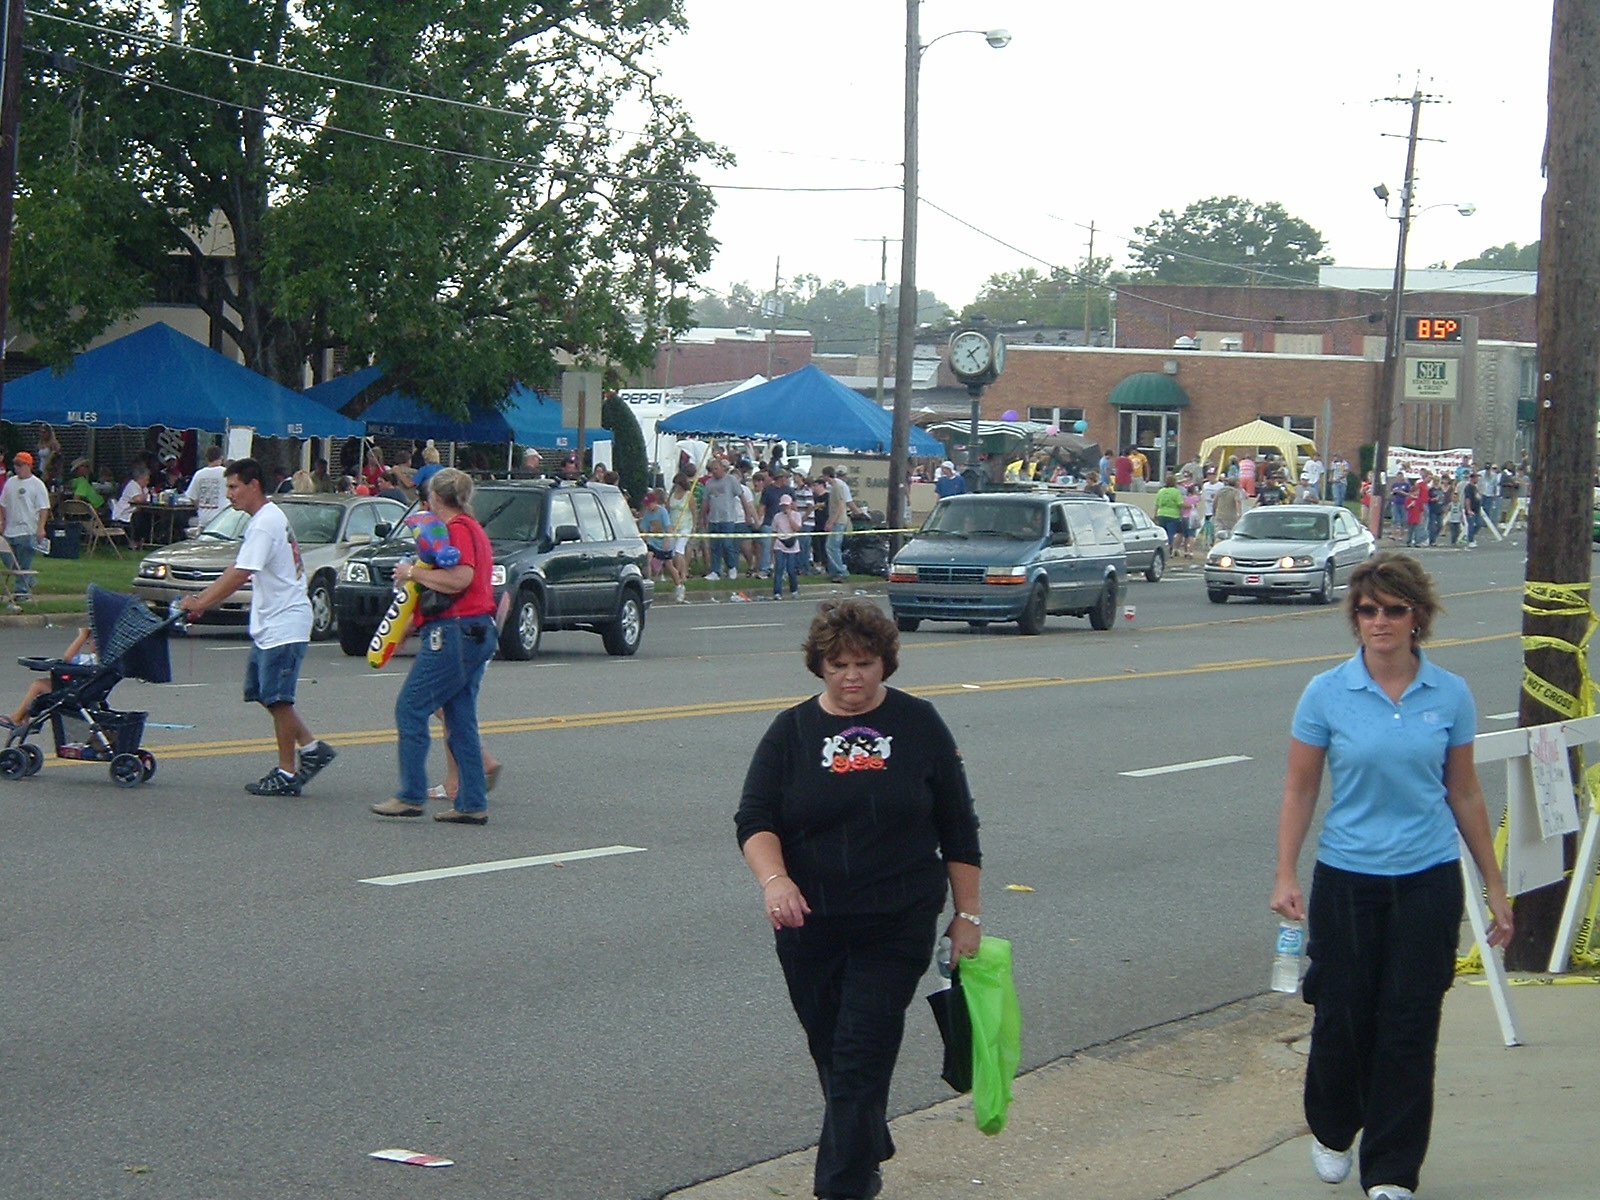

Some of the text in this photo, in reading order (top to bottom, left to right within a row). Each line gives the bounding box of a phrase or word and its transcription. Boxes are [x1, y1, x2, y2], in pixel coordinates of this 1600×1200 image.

[621, 392, 662, 404] PEPSI
[67, 411, 98, 422] MILES
[1527, 676, 1573, 710] NOT CROSS
[1574, 918, 1591, 956] CAUTION
